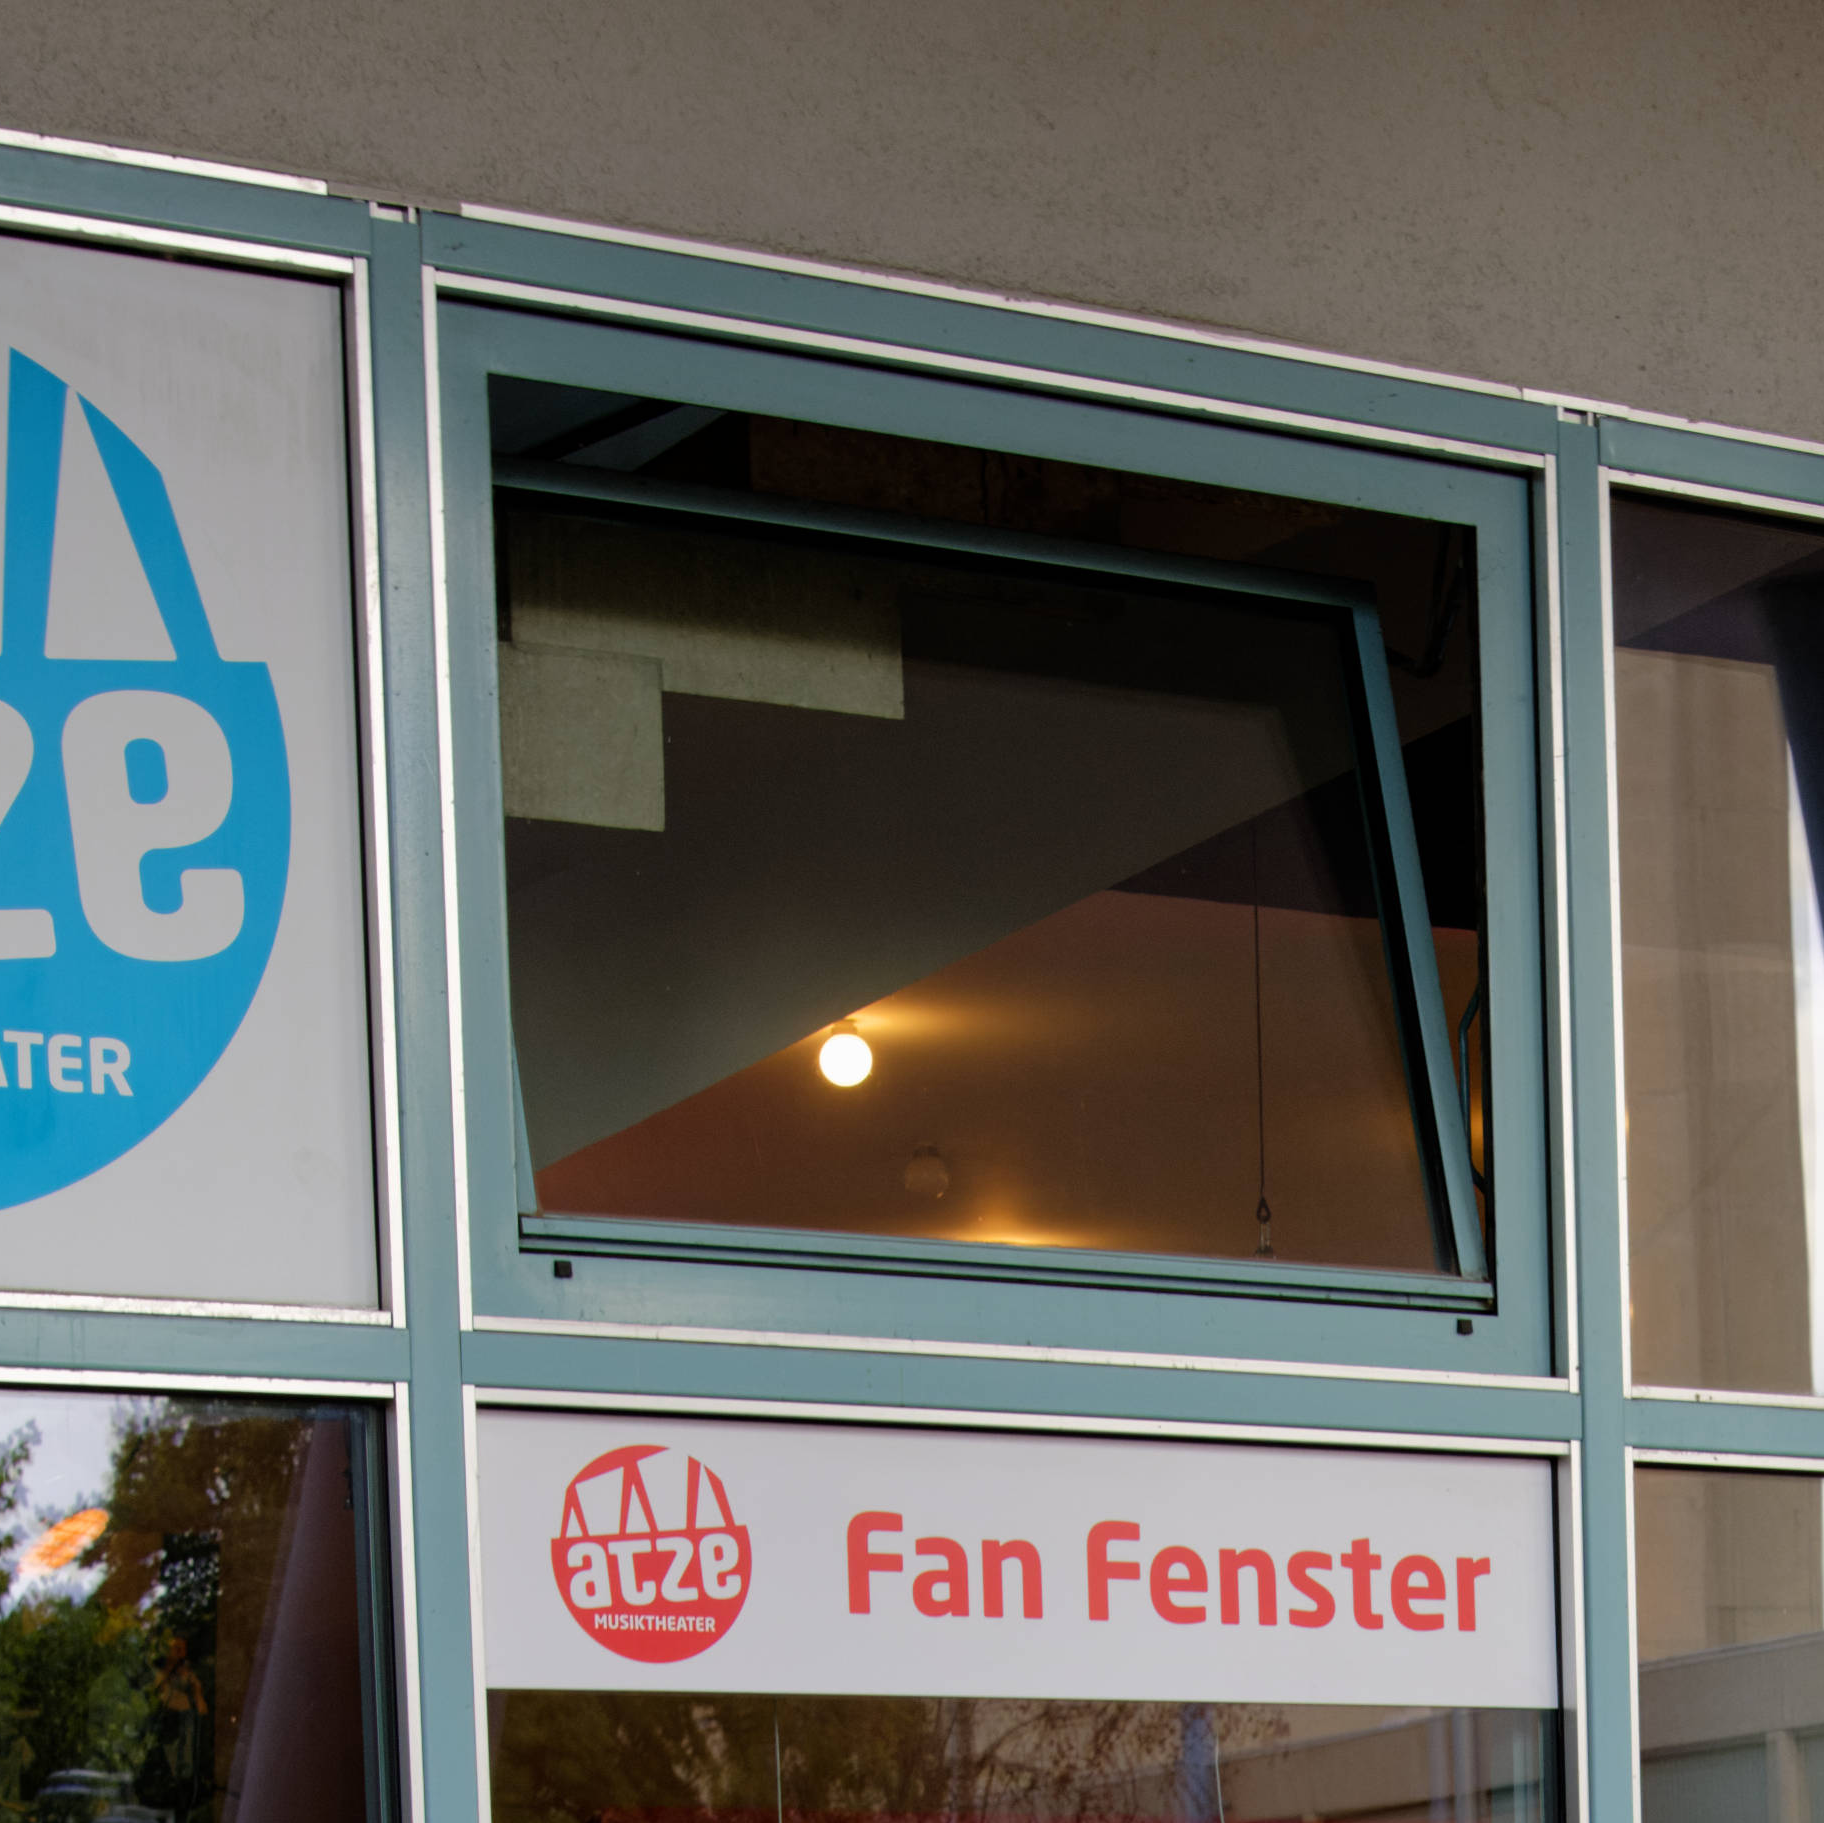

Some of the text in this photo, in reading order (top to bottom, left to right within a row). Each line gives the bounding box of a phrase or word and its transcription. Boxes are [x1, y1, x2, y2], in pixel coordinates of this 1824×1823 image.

[567, 1530, 742, 1610] atze
[846, 1511, 1491, 1632] Fan Fenster
[594, 1613, 716, 1633] MUSIKTHEATER
